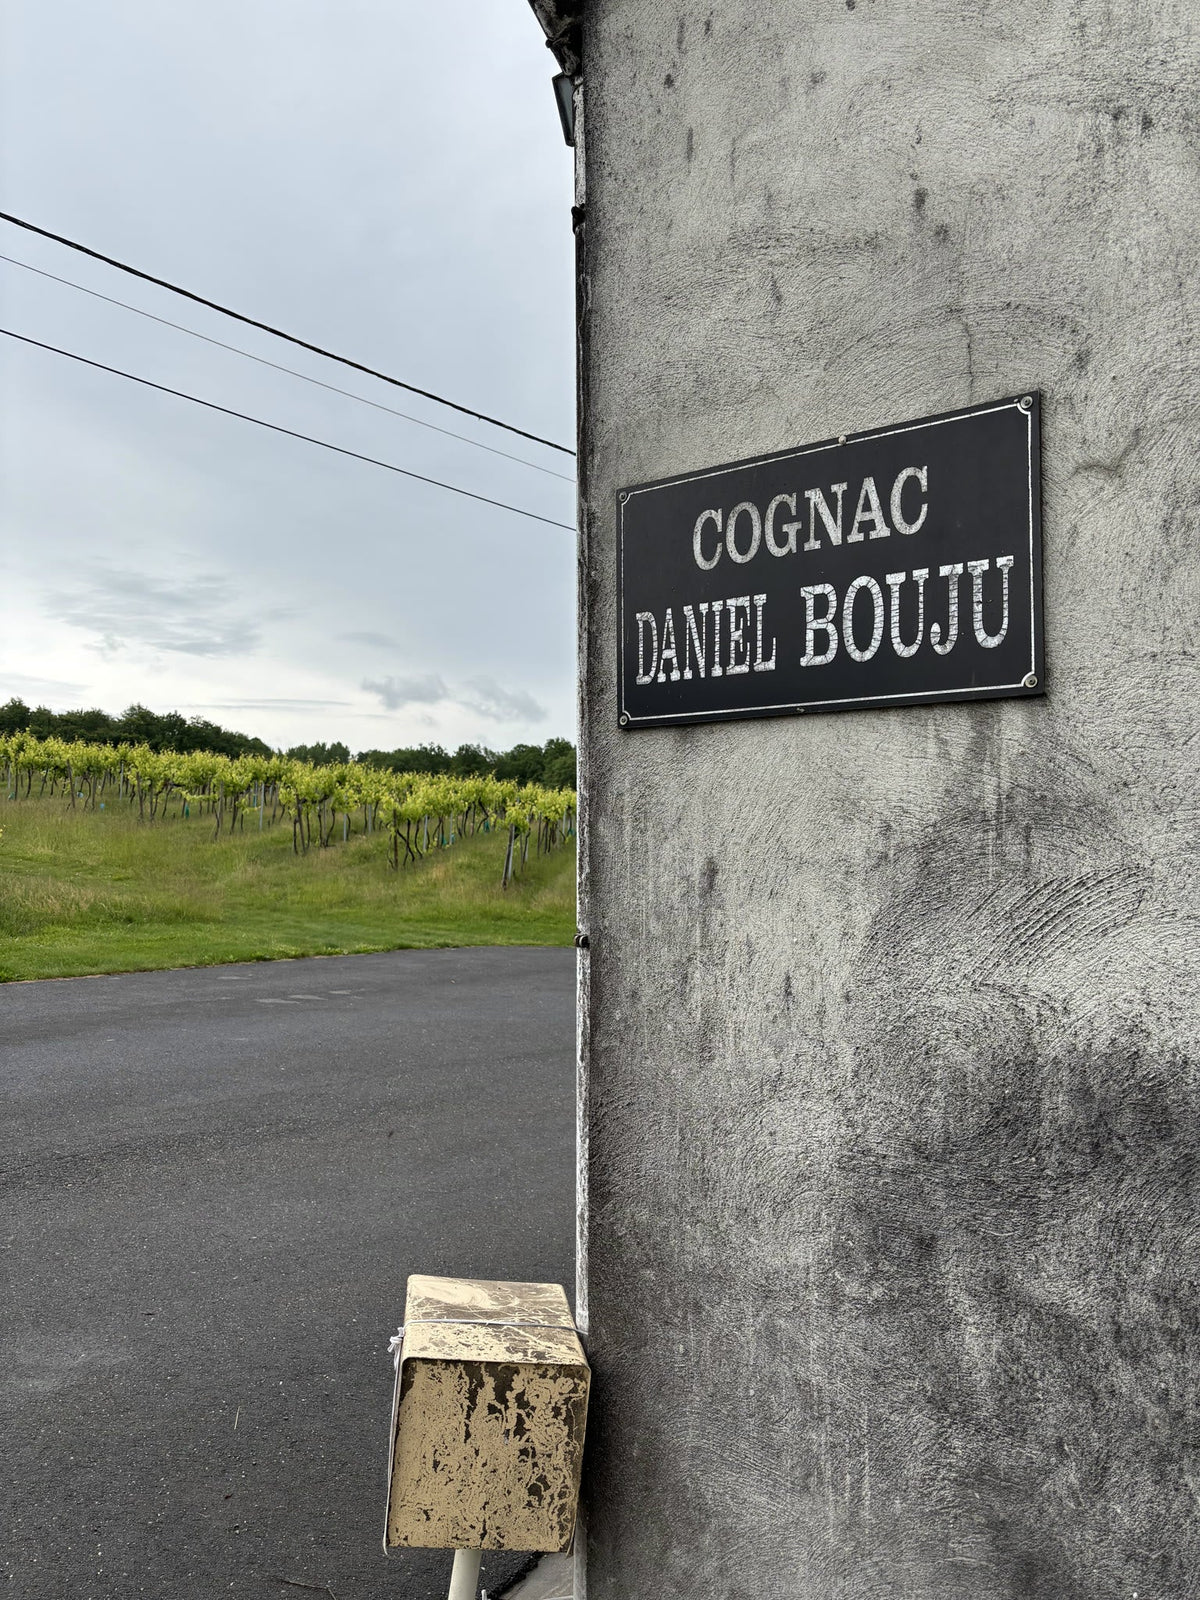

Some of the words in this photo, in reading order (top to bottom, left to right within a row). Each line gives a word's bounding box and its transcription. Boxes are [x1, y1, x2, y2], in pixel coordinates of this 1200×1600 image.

[692, 465, 929, 571] COGNAC
[635, 593, 777, 686] DANIEL
[799, 555, 1015, 668] BOUJU
